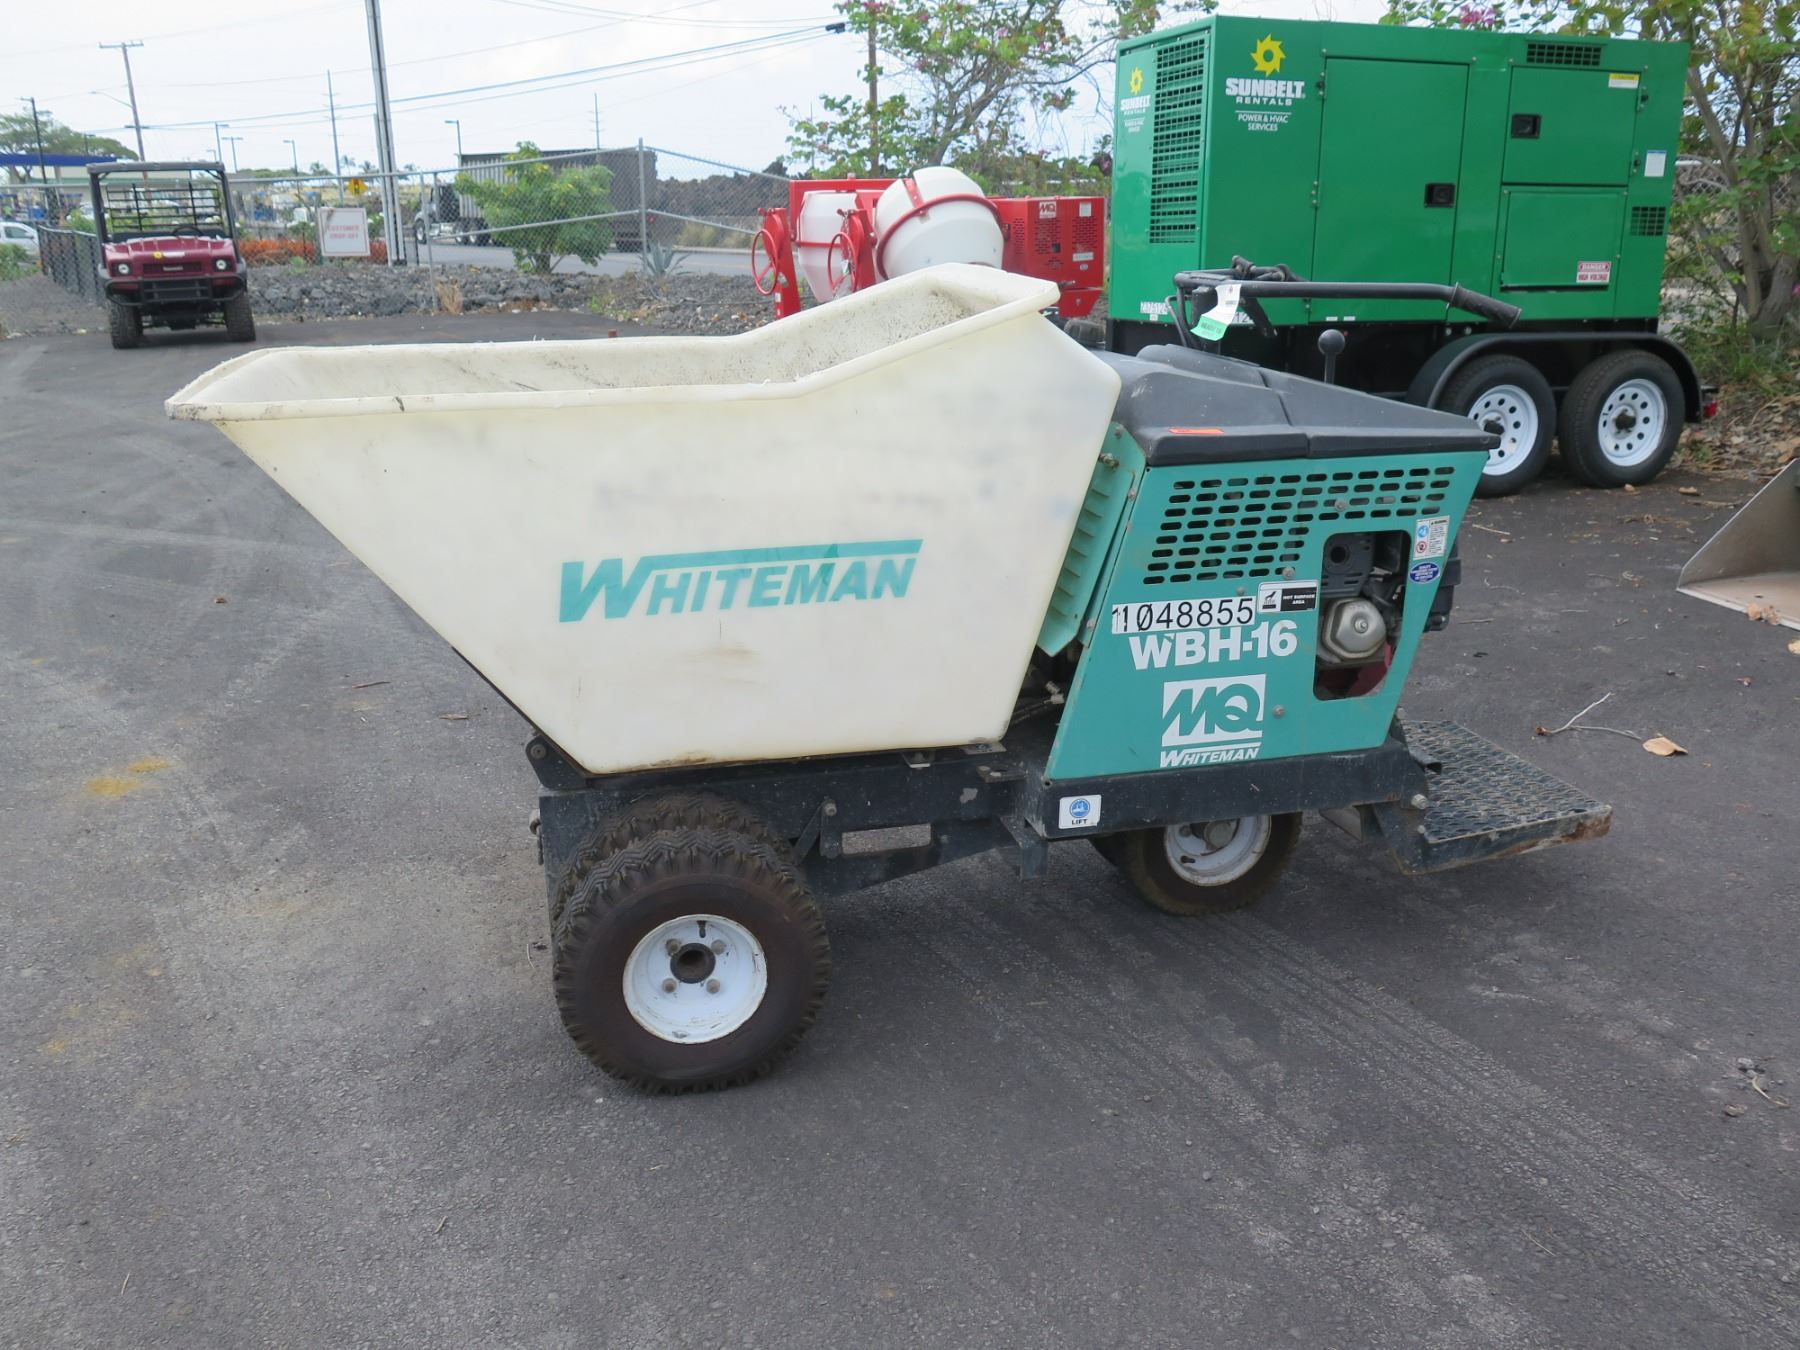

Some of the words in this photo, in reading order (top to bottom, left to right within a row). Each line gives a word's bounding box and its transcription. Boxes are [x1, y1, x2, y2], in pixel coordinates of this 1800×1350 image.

[1225, 77, 1305, 99] SUNBELT
[1120, 95, 1151, 111] SUNBELT
[1235, 96, 1293, 106] RENTALS
[1238, 113, 1262, 122] POWER
[1262, 114, 1269, 122] &
[1269, 114, 1289, 123] HVAC
[1247, 122, 1278, 131] SERVICES
[559, 540, 923, 622] WHITEMAN
[1129, 619, 1299, 671] WBH-16
[1161, 680, 1265, 743] MQ
[1160, 745, 1261, 768] WHITEMAN
